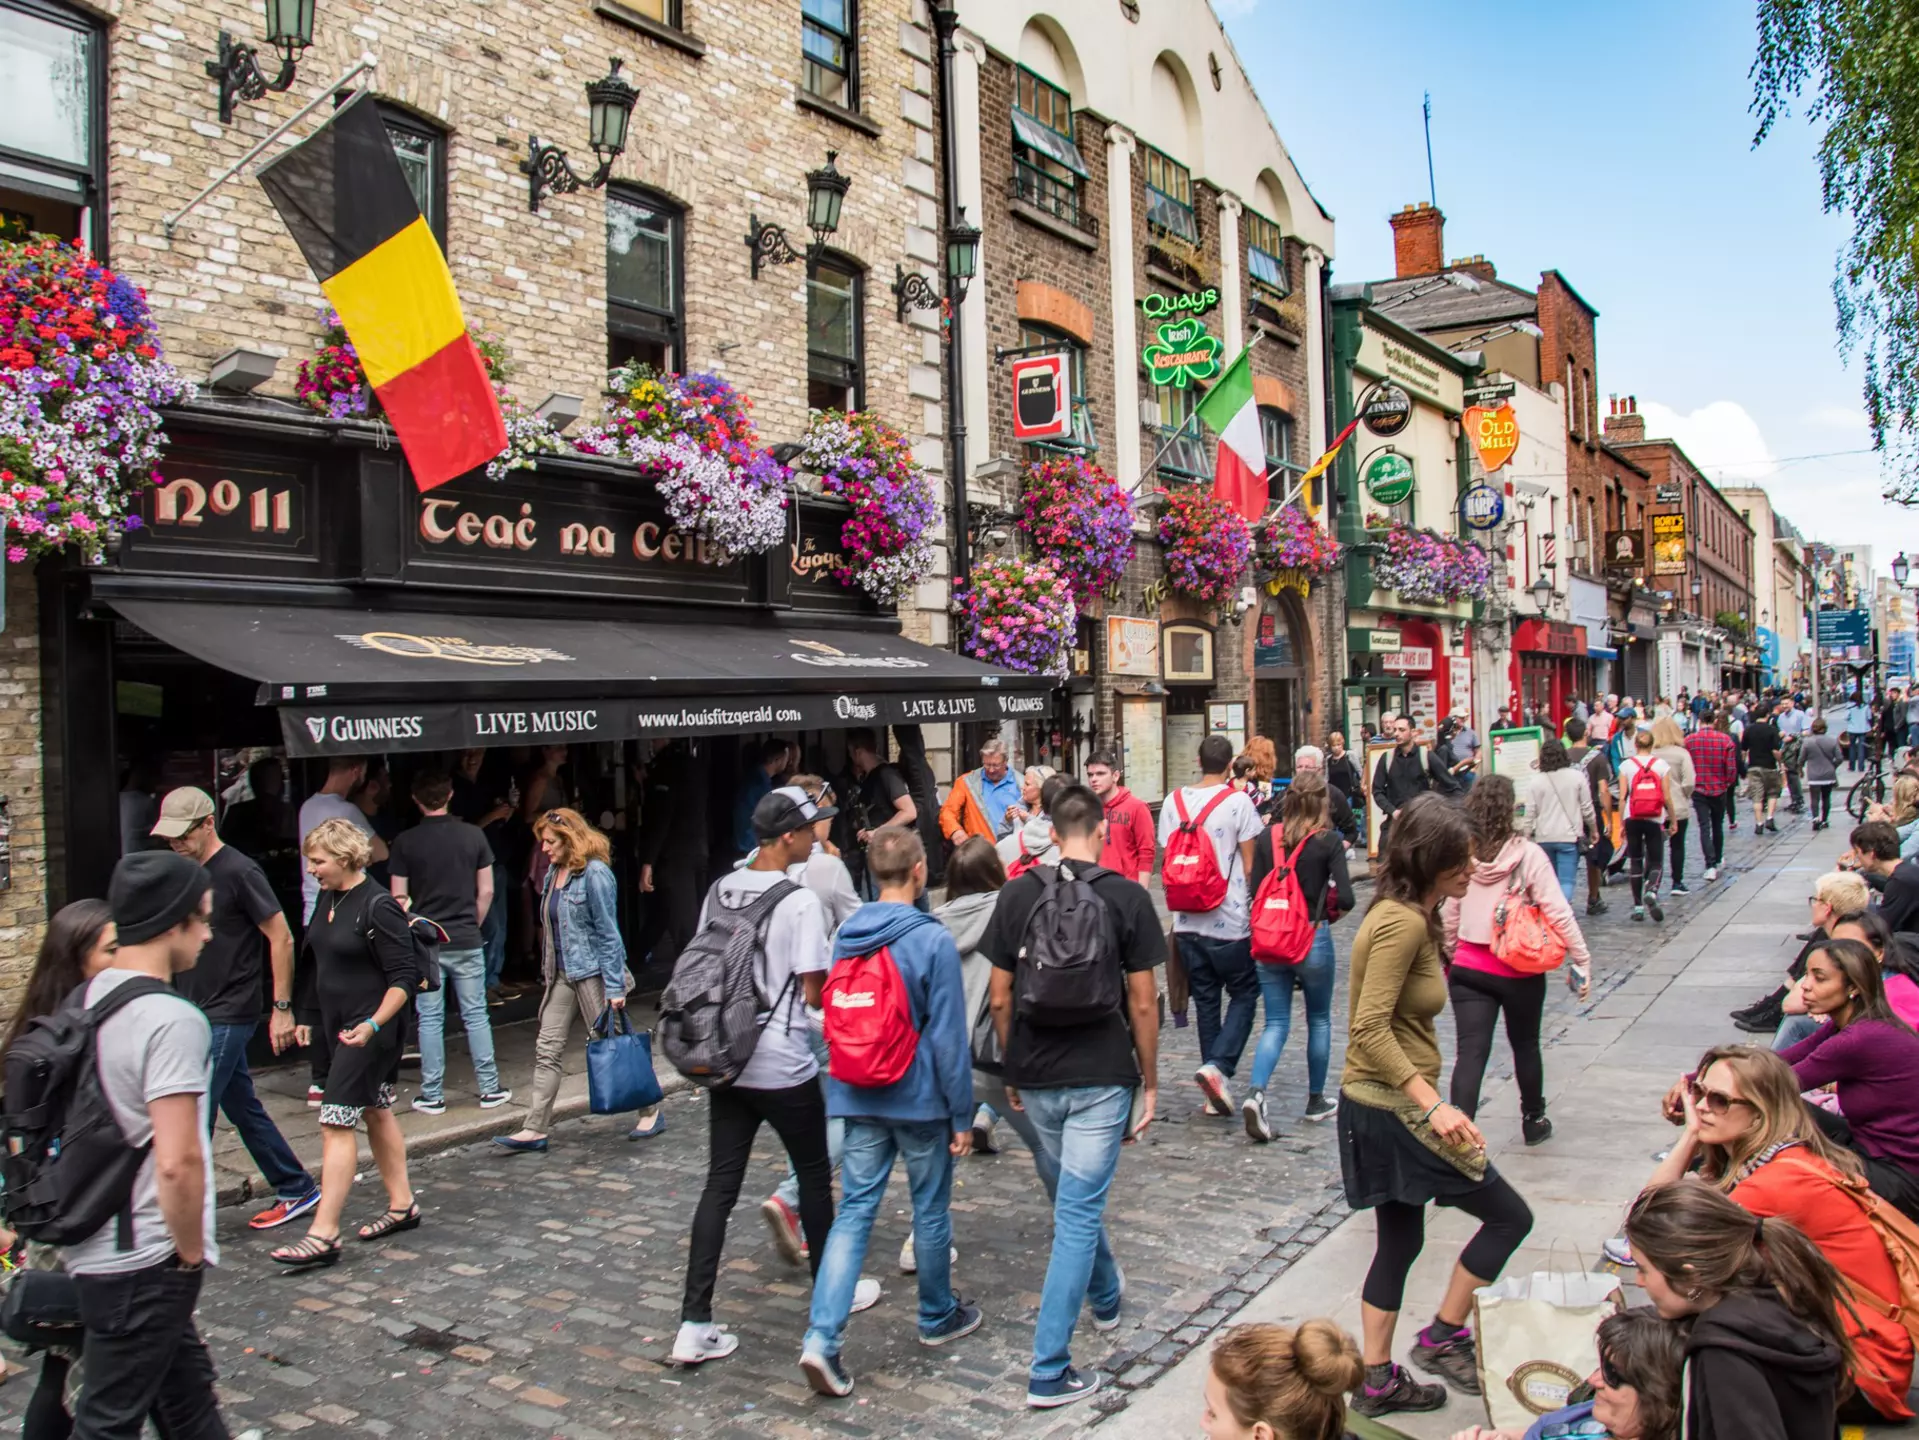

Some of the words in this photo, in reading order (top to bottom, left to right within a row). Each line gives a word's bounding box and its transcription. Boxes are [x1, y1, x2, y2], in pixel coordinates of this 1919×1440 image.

[1143, 288, 1217, 318] Quays
[1367, 401, 1408, 414] UINNESS
[1480, 436, 1514, 450] MILL
[937, 699, 947, 716] &
[949, 697, 977, 715] LIVE
[331, 716, 423, 742] GUINNESS
[474, 712, 529, 735] LIVE
[531, 709, 598, 733] MUSIC
